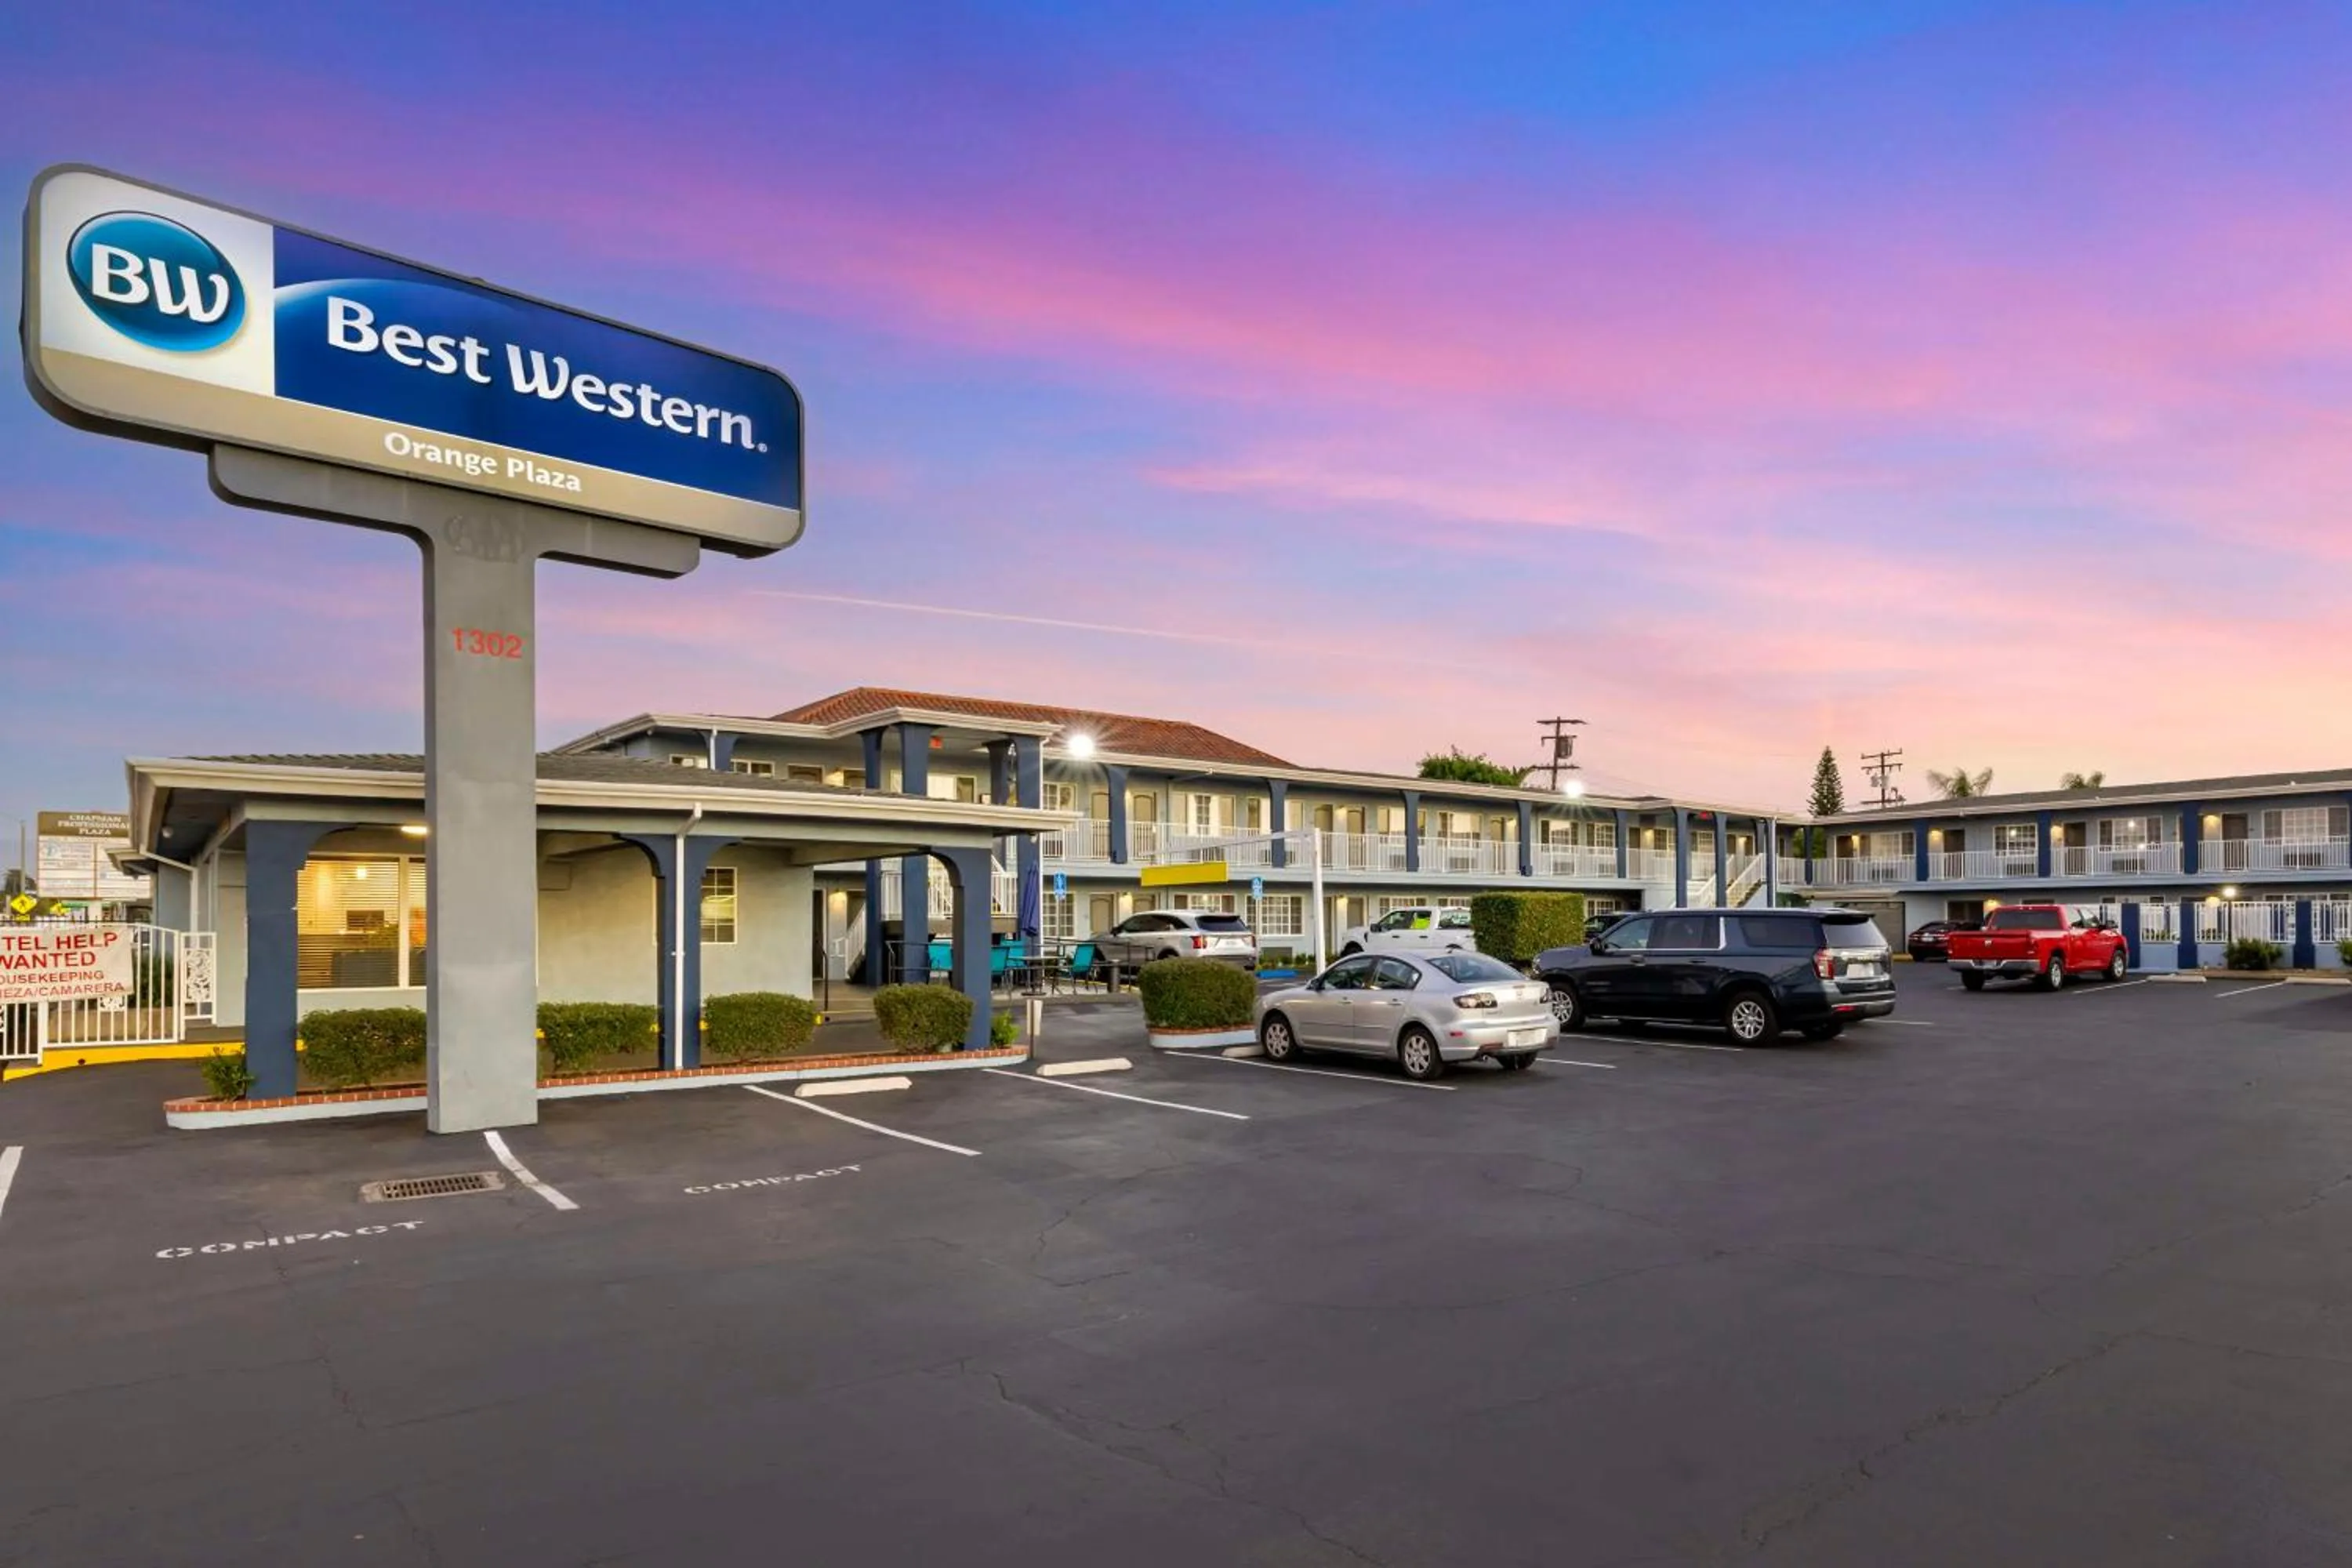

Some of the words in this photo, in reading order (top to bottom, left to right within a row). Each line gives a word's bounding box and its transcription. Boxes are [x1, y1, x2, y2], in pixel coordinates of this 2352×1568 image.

[92, 243, 230, 325] BW
[328, 295, 492, 383] Best
[506, 343, 757, 451] Western
[383, 432, 499, 476] Orange
[506, 456, 583, 492] Plaza
[452, 626, 524, 659] 1302
[56, 932, 118, 949] HELP
[0, 951, 96, 969] WANTED
[684, 1164, 861, 1195] COMPACT
[156, 1221, 426, 1258] COMPACT
